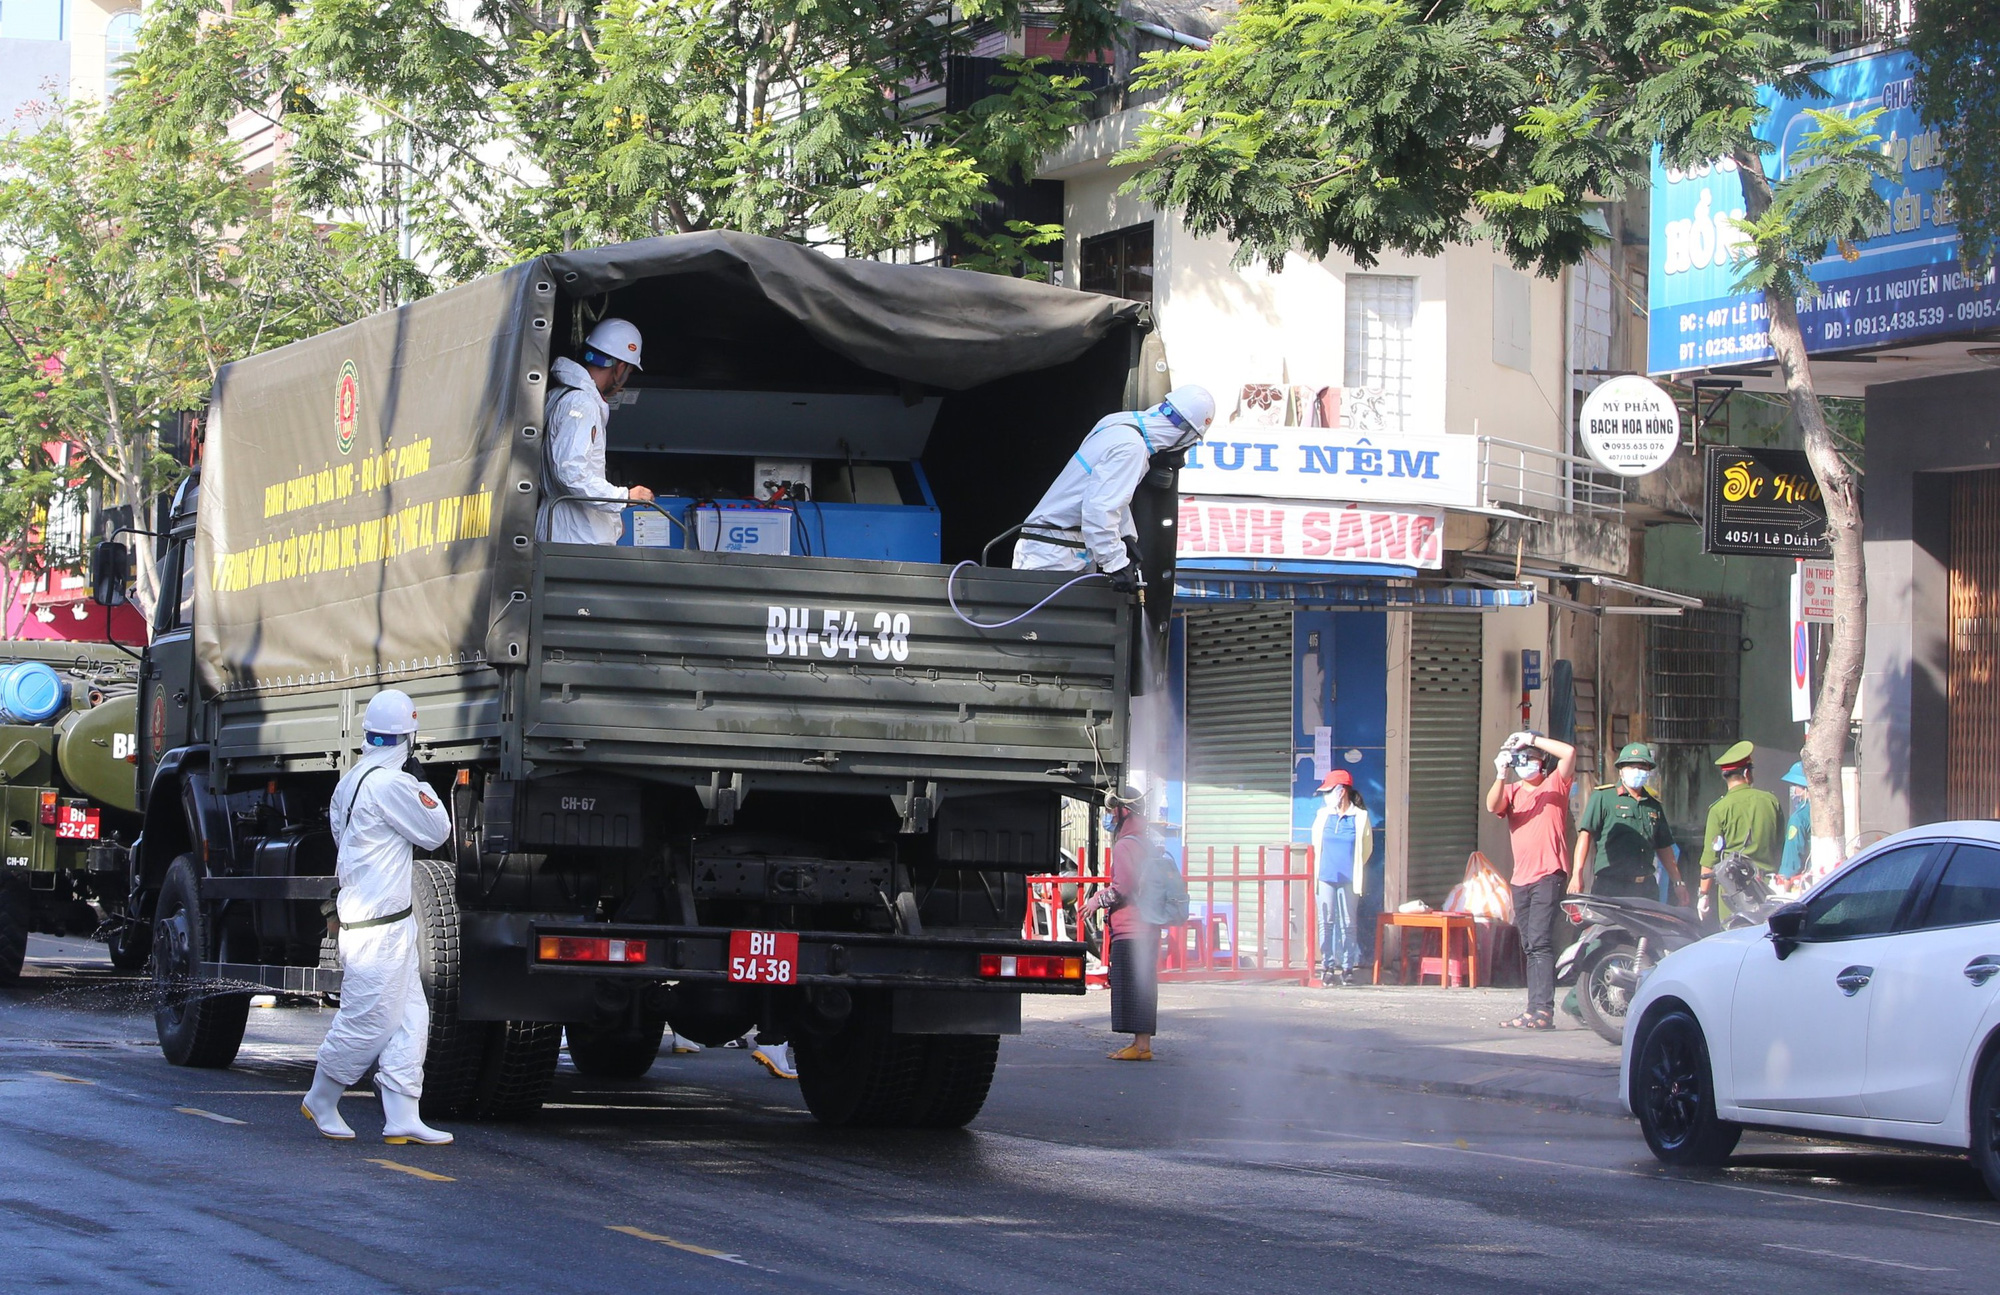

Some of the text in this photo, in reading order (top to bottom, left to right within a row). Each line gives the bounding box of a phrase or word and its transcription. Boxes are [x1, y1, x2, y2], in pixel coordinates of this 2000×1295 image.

[1893, 187, 1921, 233] SÊN
[1706, 308, 1729, 328] 407
[1732, 301, 1747, 325] LÊ
[1751, 302, 1770, 321] DU
[1816, 284, 1851, 311] NẴNG
[1866, 286, 1881, 304] 11
[1886, 269, 1938, 301] NGUYỄN
[1705, 331, 1773, 357] 0236.3820
[1854, 306, 1944, 336] 0913.438.539
[1590, 418, 1618, 437] BẠCH
[1622, 418, 1642, 435] HOA
[1299, 437, 1440, 484] NỆM
[729, 526, 759, 543] GS
[1302, 503, 1438, 560] SÁNG
[1725, 530, 1759, 543] 405/1
[1764, 532, 1780, 545] Lê
[1805, 567, 1814, 578] IN
[765, 606, 912, 662] BH-54-38
[70, 808, 86, 823] BH
[561, 796, 596, 811] CH-67
[59, 822, 96, 839] 52-45
[749, 932, 776, 956] BH
[732, 957, 791, 982] 54-38
